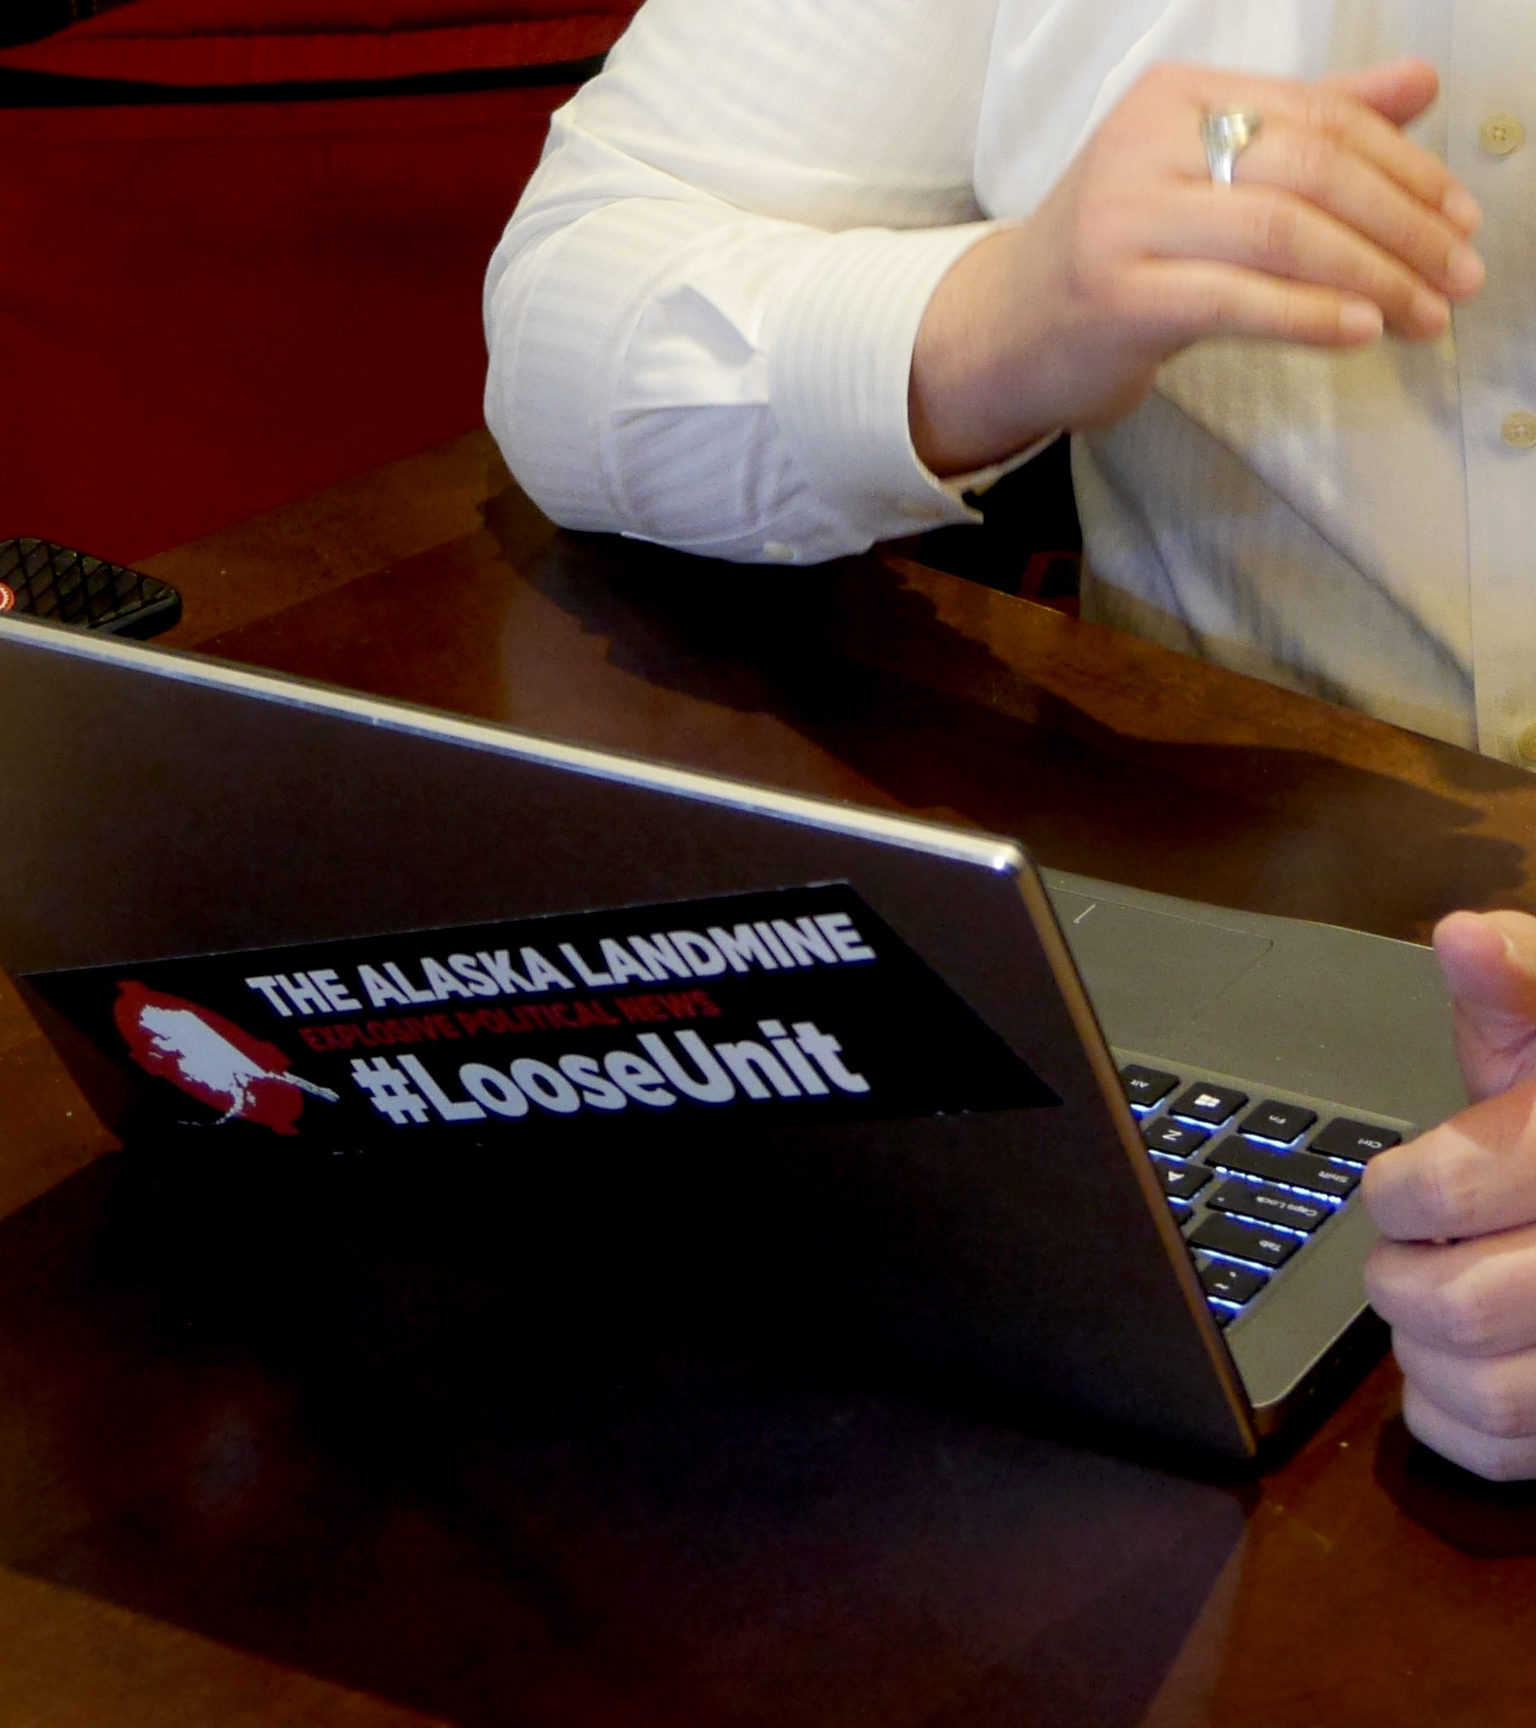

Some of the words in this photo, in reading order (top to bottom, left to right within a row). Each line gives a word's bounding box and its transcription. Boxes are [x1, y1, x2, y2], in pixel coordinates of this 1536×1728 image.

[244, 968, 363, 1017] THE
[357, 946, 575, 1008] ALASKA
[557, 912, 877, 987] LANDMINE
[297, 1013, 462, 1052] EXPLOSIVE
[454, 999, 621, 1037] POLITICAL
[614, 989, 722, 1023] NEWS
[349, 1019, 871, 1125] #LooseUnit
[1162, 1129, 1183, 1141] Z
[1357, 1138, 1382, 1149] Ctrl
[1167, 1170, 1185, 1182] A
[1318, 1169, 1349, 1184] Shift
[1256, 1195, 1287, 1210] Lock
[1287, 1200, 1317, 1217] Caps
